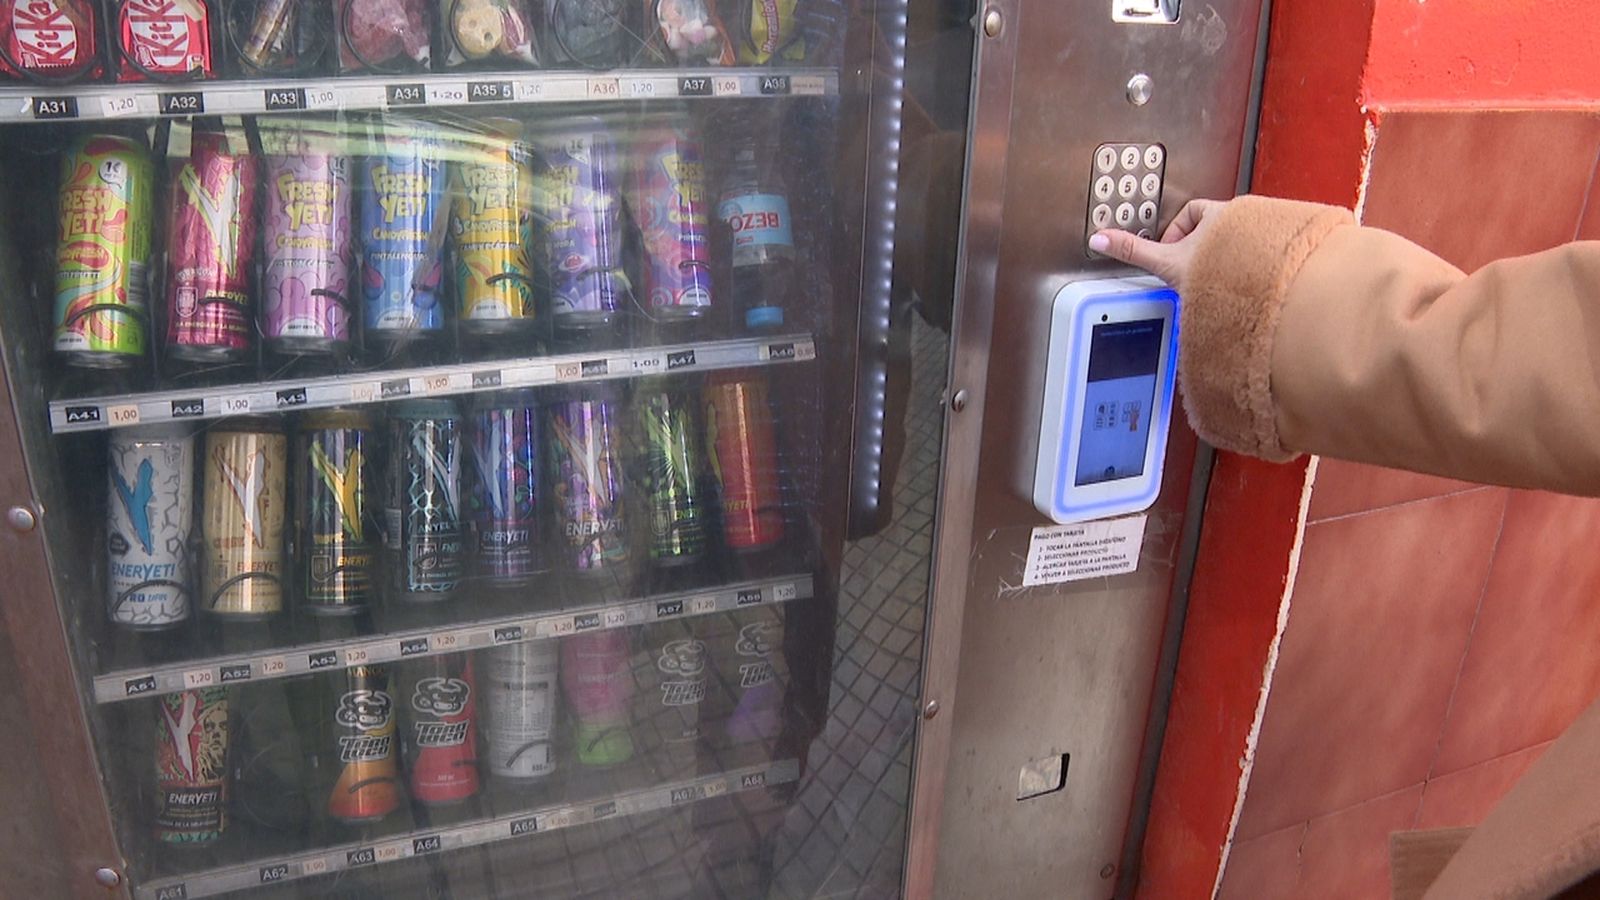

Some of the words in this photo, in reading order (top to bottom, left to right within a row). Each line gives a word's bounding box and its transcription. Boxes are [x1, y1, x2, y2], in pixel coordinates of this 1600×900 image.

[14, 0, 73, 66] KitKa
[593, 83, 615, 95] A36
[632, 83, 652, 93] 1,20
[683, 79, 705, 91] A37
[718, 82, 736, 92] 1,00
[311, 91, 333, 104] 1,00
[394, 88, 420, 100] A34
[473, 85, 497, 96] A35
[503, 86, 510, 98] 5
[108, 98, 134, 112] 1,20
[169, 95, 197, 109] A32
[270, 92, 296, 106] A33
[39, 101, 67, 114] A31
[1105, 154, 1110, 165] 1
[1127, 153, 1134, 165] 2
[1150, 152, 1157, 163] 3
[372, 165, 429, 193] FRESH
[278, 171, 339, 202] FRESH
[1101, 183, 1108, 193] 4
[1125, 182, 1132, 193] 5
[471, 187, 516, 215] YETI
[379, 193, 427, 223] YETI
[285, 202, 333, 230] YETI
[1099, 211, 1105, 222] 7
[1122, 210, 1129, 221] 8
[1145, 208, 1152, 219] 9
[728, 212, 779, 232] BEZO
[558, 367, 578, 377] 1,00
[426, 378, 448, 389] 1,00
[278, 394, 306, 404] A43
[352, 389, 373, 399] 1,00
[173, 405, 203, 415] A42
[226, 399, 248, 410] 1,00
[68, 411, 99, 421] A41
[114, 409, 137, 420] 1,00
[112, 563, 176, 582] ENERYETI
[779, 588, 795, 598] 1,20
[698, 600, 714, 609] 1,20
[607, 614, 625, 624] 1,20
[554, 621, 572, 632] 1,20
[436, 636, 455, 647] 1,20
[347, 652, 366, 662] 1,20
[264, 661, 284, 671] 1,20
[190, 673, 211, 684] 1,20
[169, 793, 218, 805] ENERYETI
[416, 839, 439, 852] A64
[351, 850, 373, 864] A63
[263, 869, 287, 881] A62
